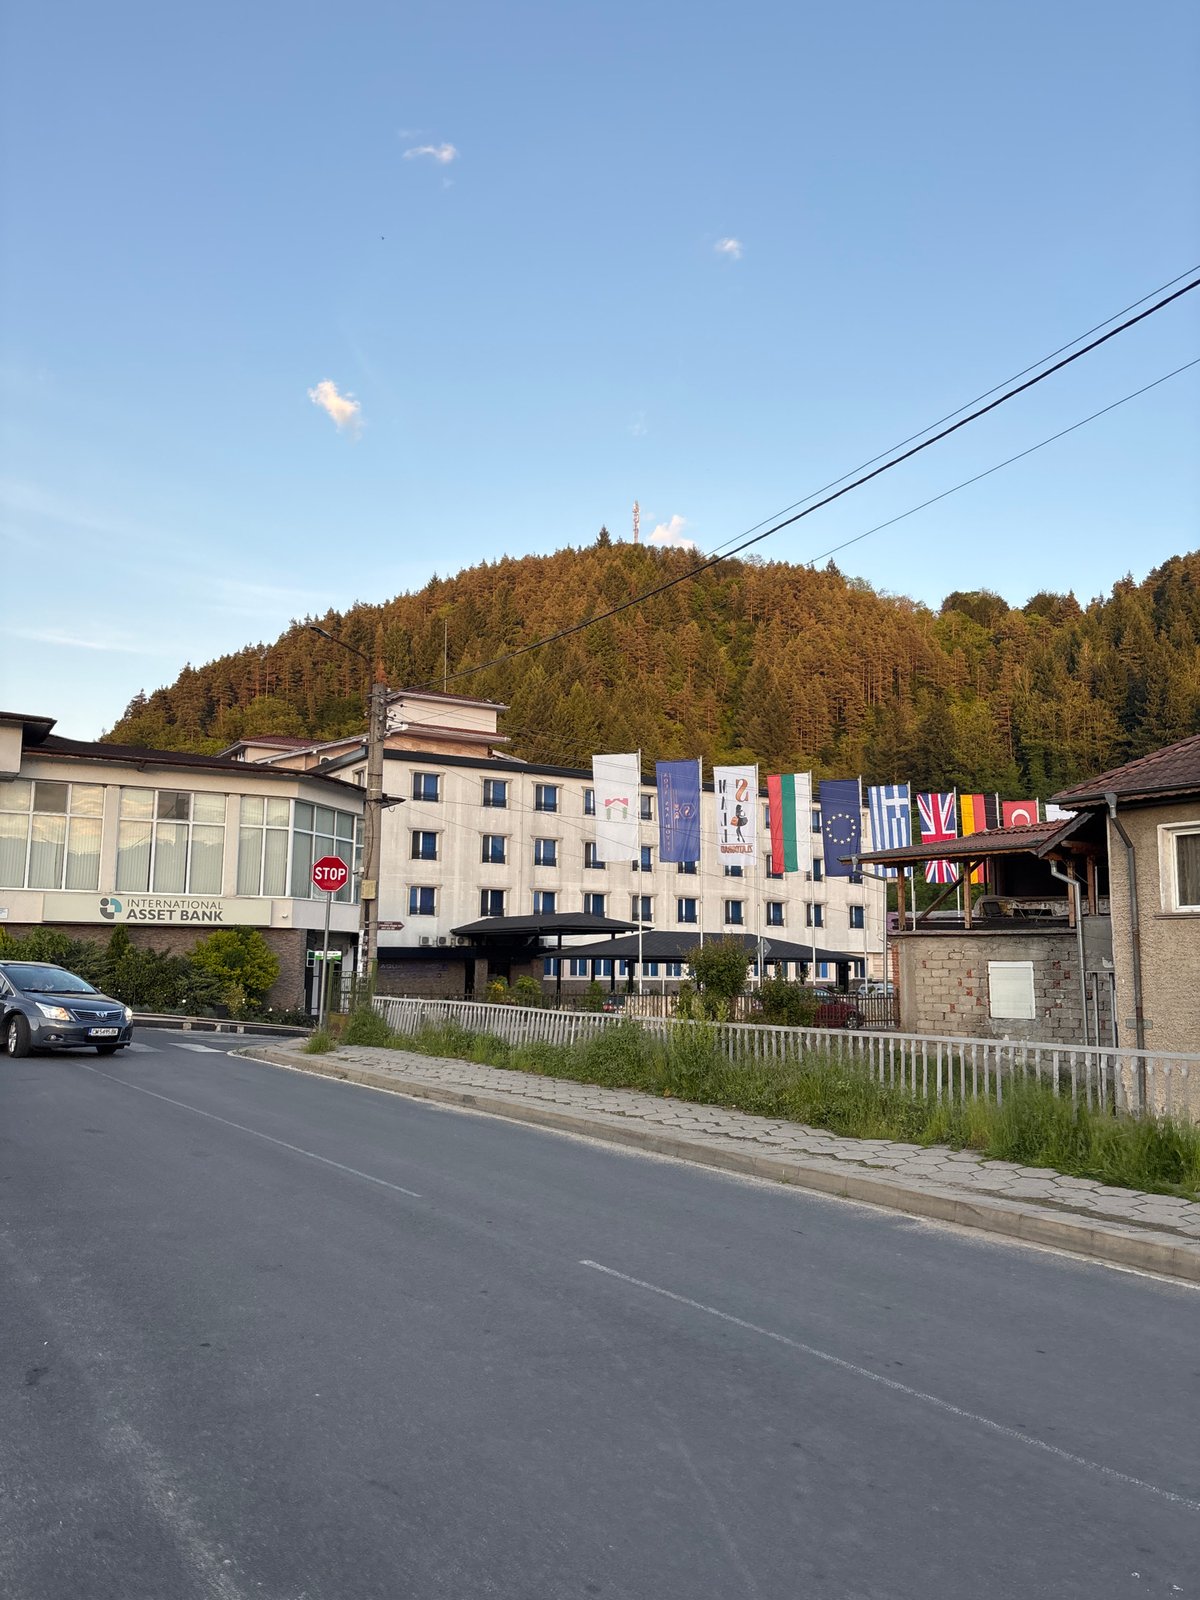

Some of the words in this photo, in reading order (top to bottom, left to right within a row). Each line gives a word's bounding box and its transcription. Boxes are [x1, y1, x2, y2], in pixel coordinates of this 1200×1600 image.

[315, 867, 345, 880] STOP
[127, 899, 223, 910] INTERNATIONAL
[127, 909, 176, 921] ASSET
[180, 910, 223, 921] BANK
